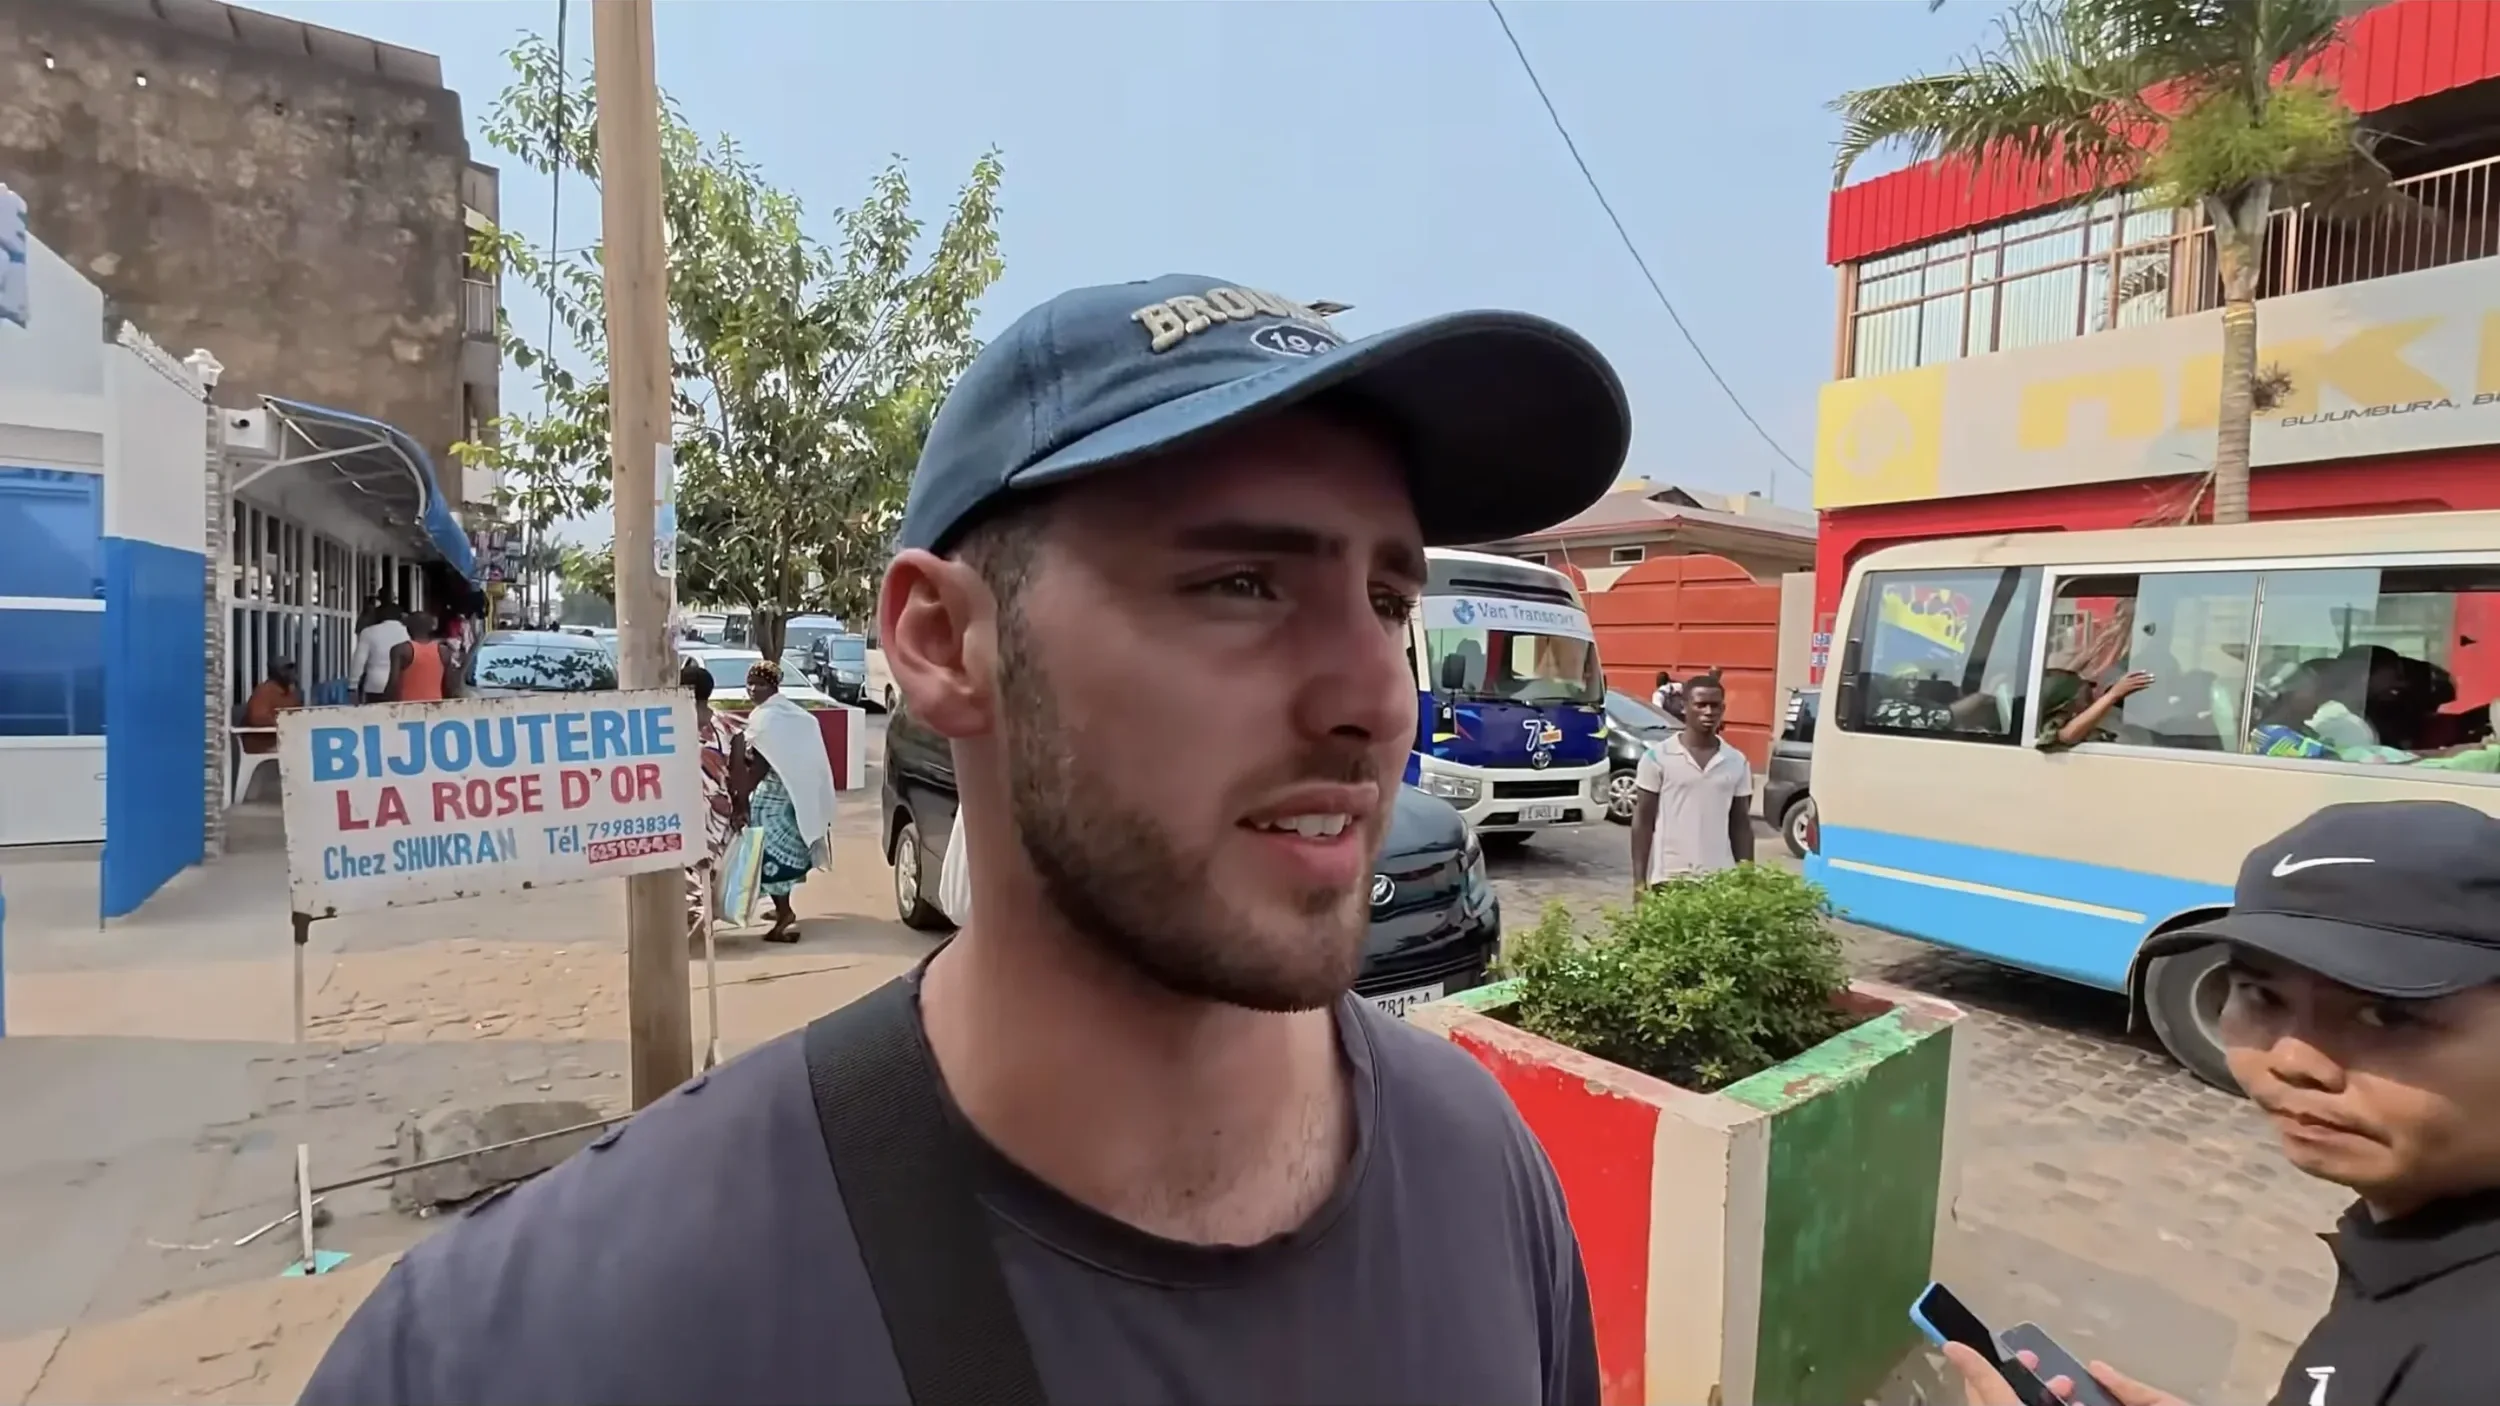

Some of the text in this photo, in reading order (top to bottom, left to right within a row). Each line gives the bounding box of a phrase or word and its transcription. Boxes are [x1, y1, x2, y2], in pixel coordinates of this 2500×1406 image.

[2281, 398, 2461, 427] BUJUMBURA,
[1477, 602, 1575, 626] Van Transport
[311, 706, 676, 782] BIJOUTERIE
[336, 763, 662, 831] LA ROSE D'OR
[323, 845, 386, 880] Chez
[393, 827, 518, 871] SHUKRAN
[587, 813, 681, 840] 79983834
